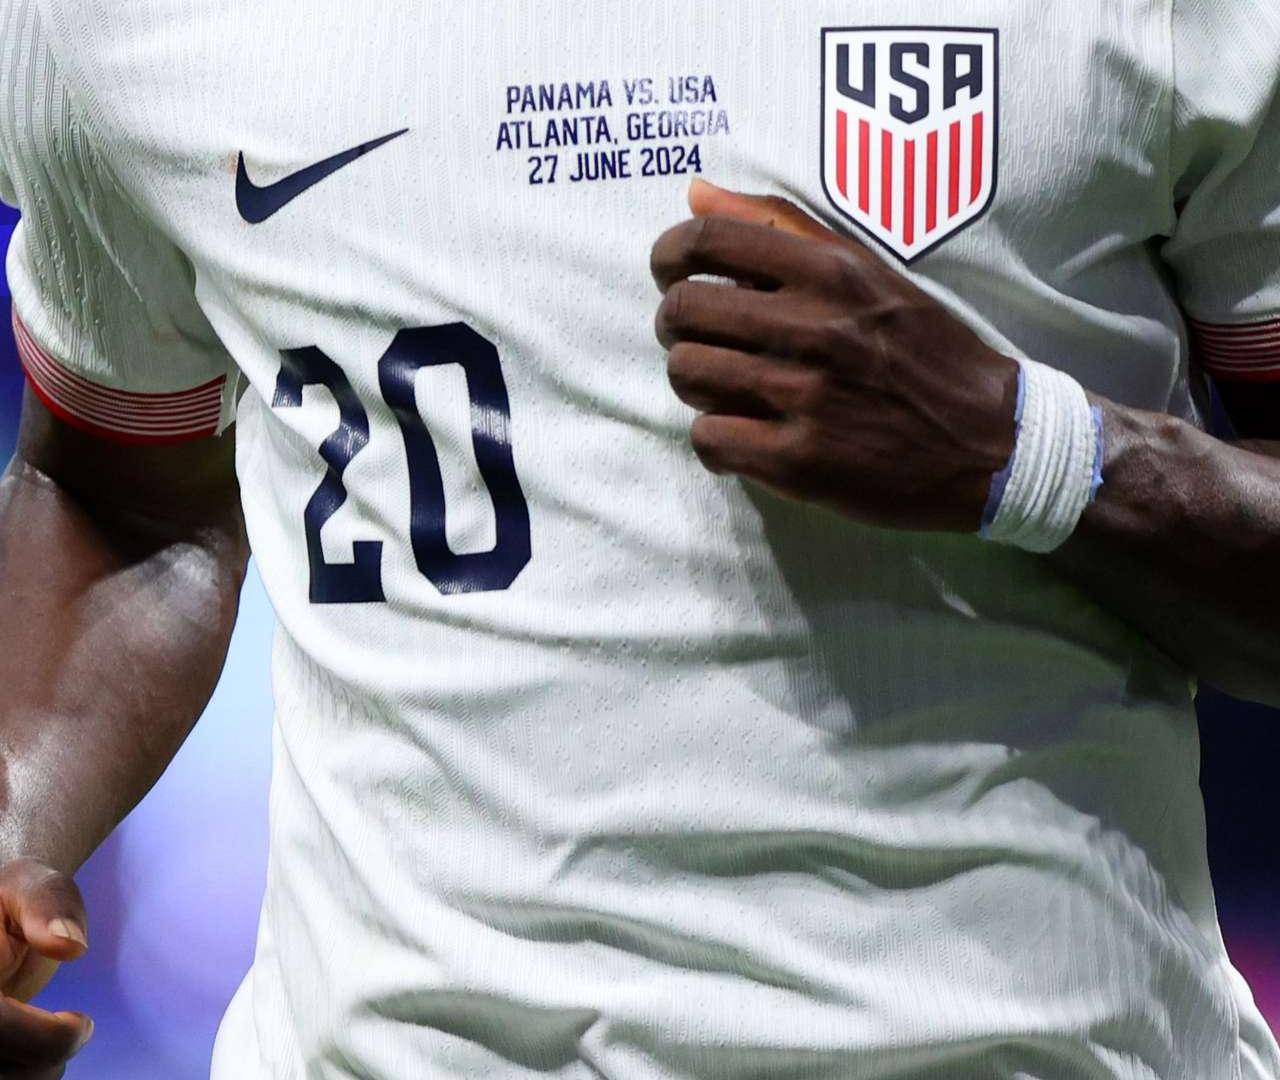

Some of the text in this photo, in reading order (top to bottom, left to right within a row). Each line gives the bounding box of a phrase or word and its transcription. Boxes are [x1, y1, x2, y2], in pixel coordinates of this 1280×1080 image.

[506, 75, 718, 114] PANAMA VS. USA
[836, 42, 983, 124] USA
[496, 110, 730, 151] ATLANTA, GEORGIA
[527, 144, 702, 185] 27 JUNE 2024
[271, 321, 532, 604] 20
